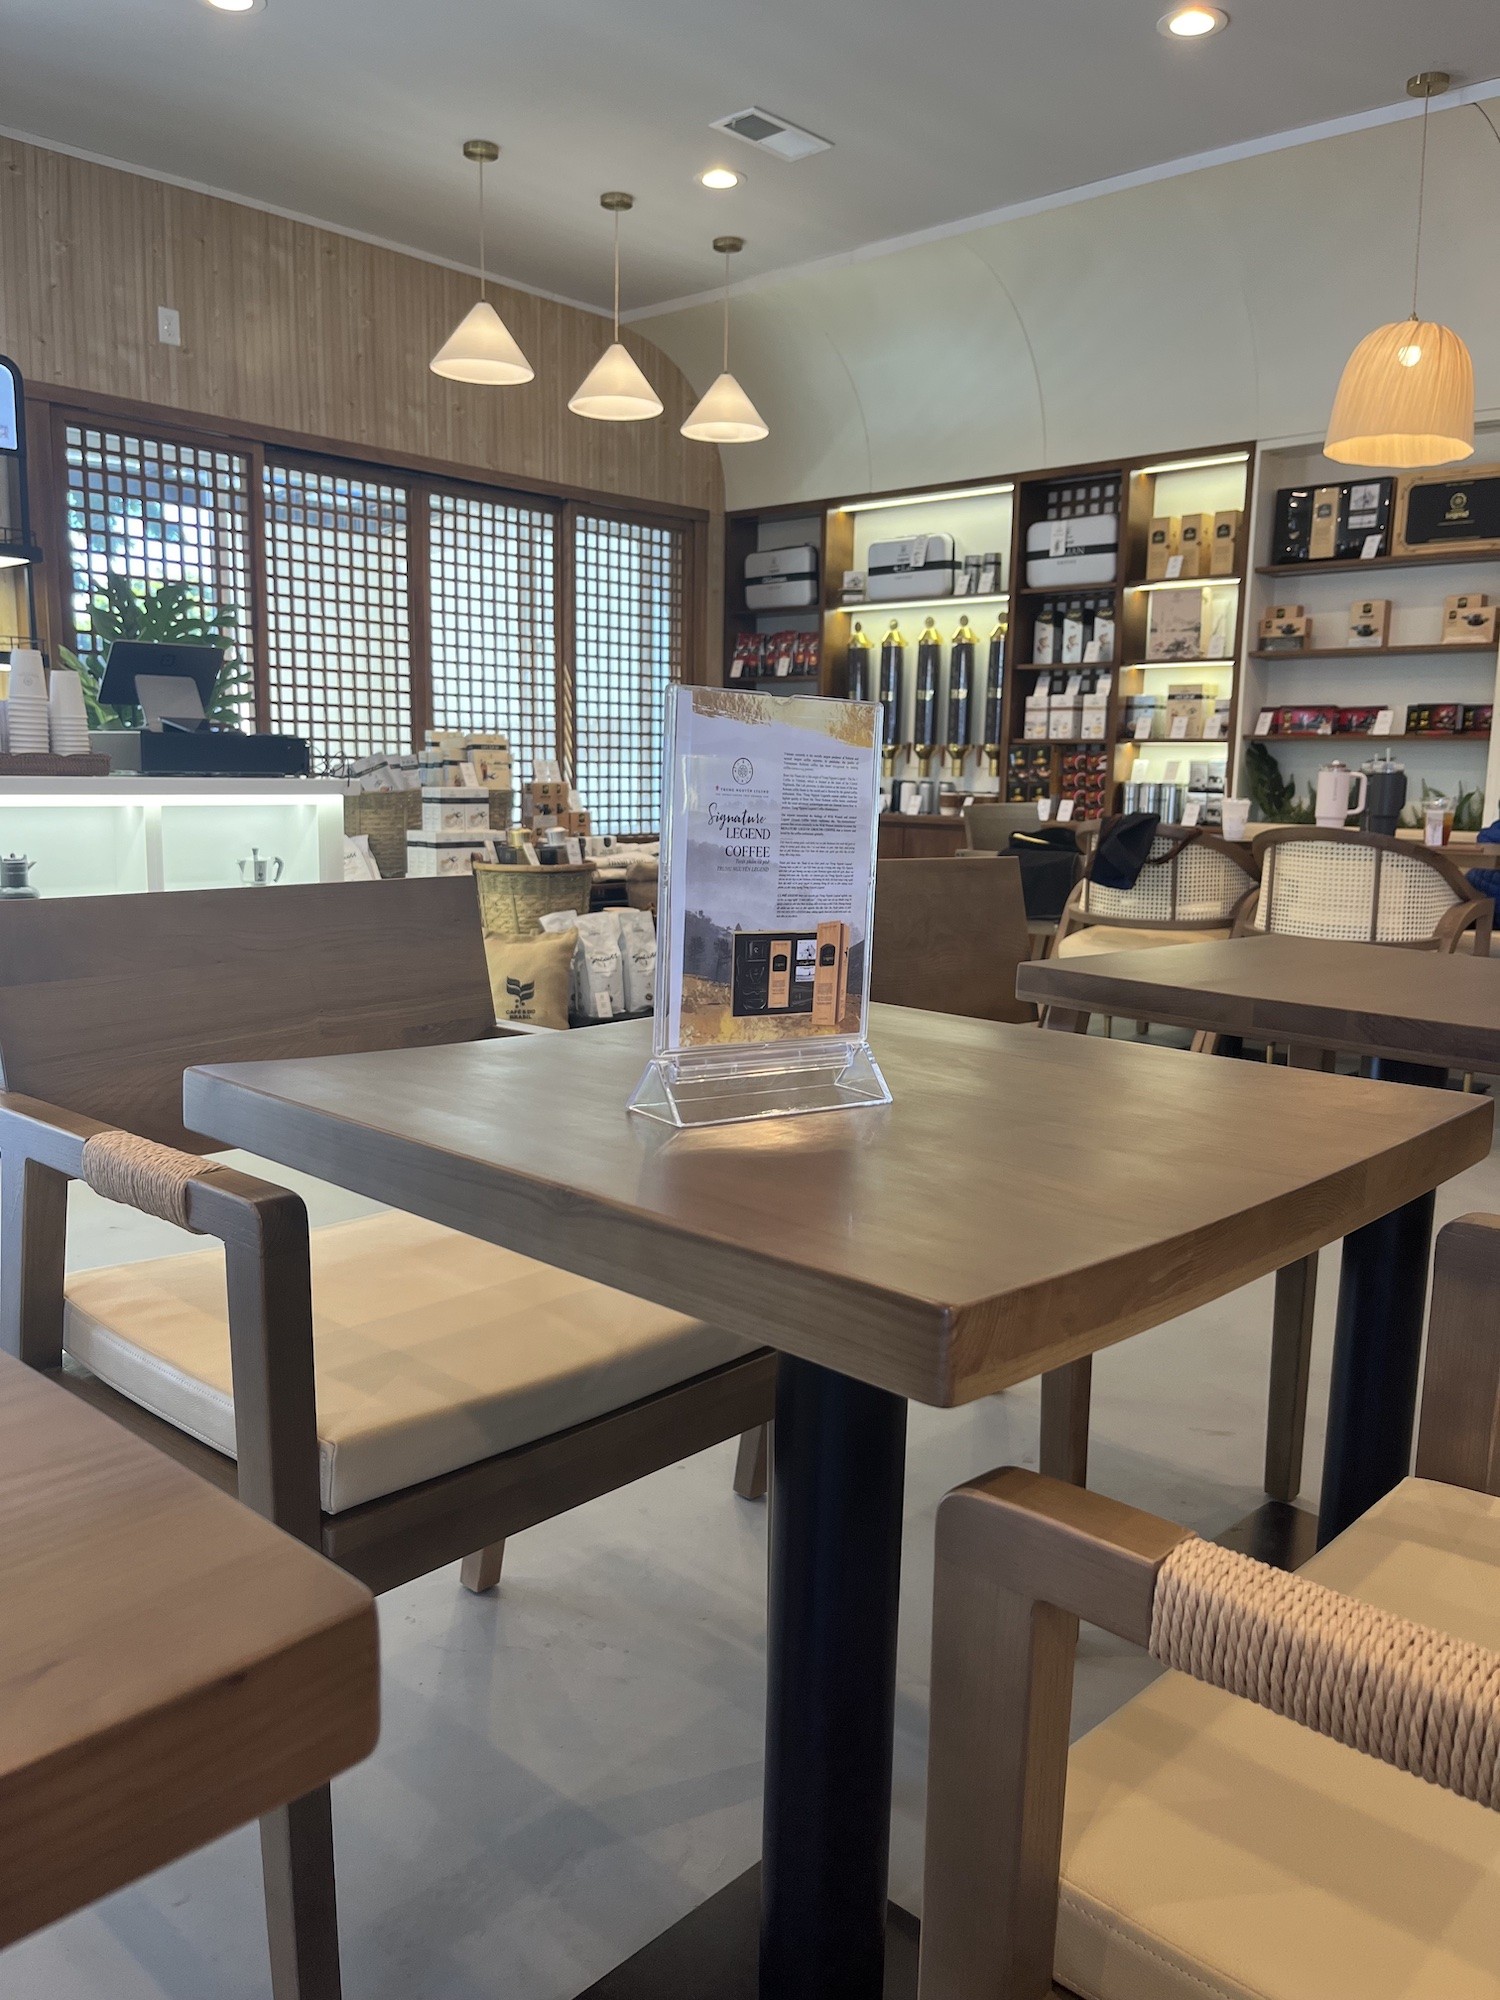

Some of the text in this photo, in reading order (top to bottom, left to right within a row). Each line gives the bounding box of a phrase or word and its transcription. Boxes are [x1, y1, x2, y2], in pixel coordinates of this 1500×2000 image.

[708, 802, 766, 831] Signature
[726, 827, 771, 840] LEGEND
[725, 845, 770, 858] COFFEE
